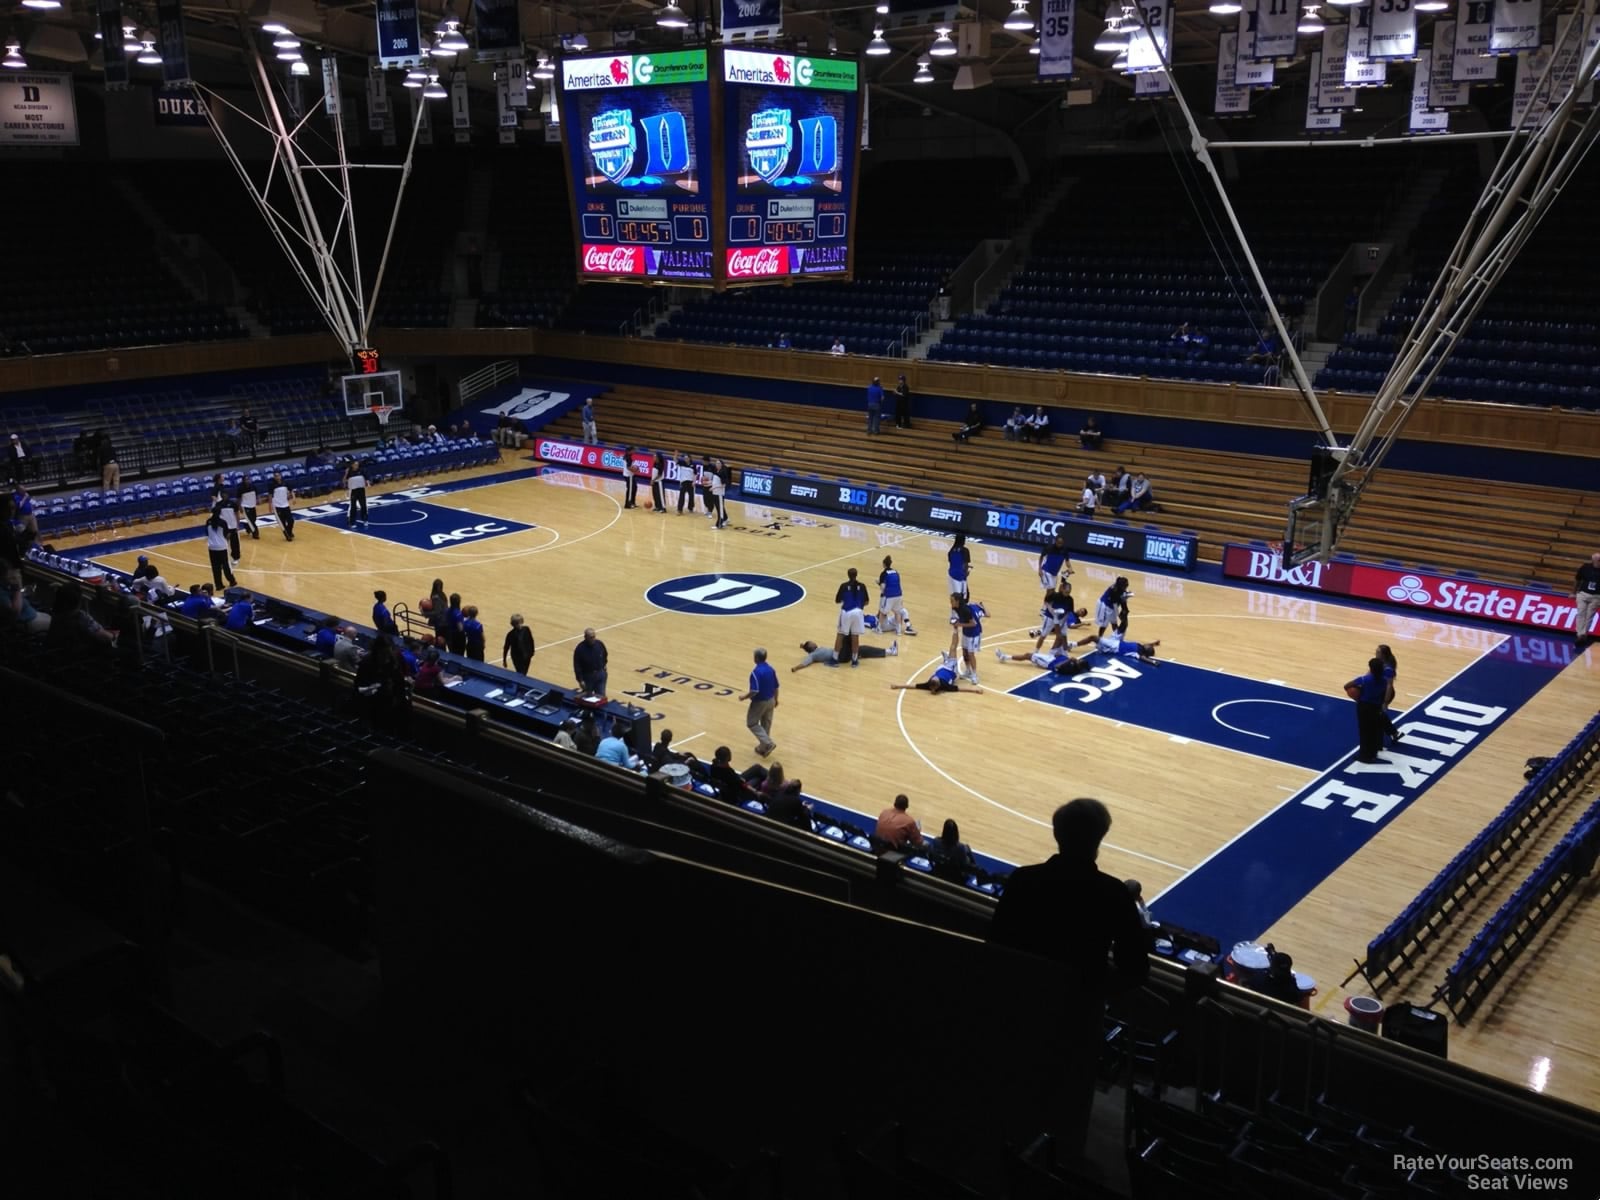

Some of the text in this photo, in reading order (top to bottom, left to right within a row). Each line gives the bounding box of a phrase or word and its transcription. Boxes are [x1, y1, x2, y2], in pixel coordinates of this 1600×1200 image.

[380, 10, 398, 21] FINAL
[738, 5, 761, 17] 2002
[1046, 17, 1069, 37] 35
[392, 38, 408, 49] 2006
[511, 63, 522, 79] 10
[729, 65, 774, 82] Ameritas
[1357, 69, 1374, 77] 1990
[567, 74, 612, 88] Ameritas
[159, 98, 206, 115] DUKE
[587, 203, 606, 211] DUKE
[672, 204, 706, 212] PURDUE
[736, 204, 756, 212] DUKE
[818, 202, 845, 211] PURDUE
[600, 217, 609, 235] 0
[693, 218, 702, 238] 0
[748, 219, 756, 238] 0
[833, 216, 841, 234] 0
[584, 246, 636, 272] Coca-Cola
[661, 250, 713, 268] VALEANT
[728, 248, 781, 276] Coca-Cola
[804, 247, 847, 264] VALEANT
[363, 359, 377, 374] 30
[550, 444, 581, 462] Castrol
[790, 485, 818, 498] ESPN
[874, 494, 907, 512] ACC
[931, 507, 962, 522] ESPN
[1027, 518, 1065, 537] ACC
[1087, 533, 1125, 549] ESPN
[1146, 540, 1187, 560] DICK'S
[430, 522, 508, 545] ACC
[1434, 581, 1516, 618] State
[634, 666, 734, 696] COURT
[1050, 658, 1143, 703] ACC
[1301, 695, 1508, 823] DUKE
